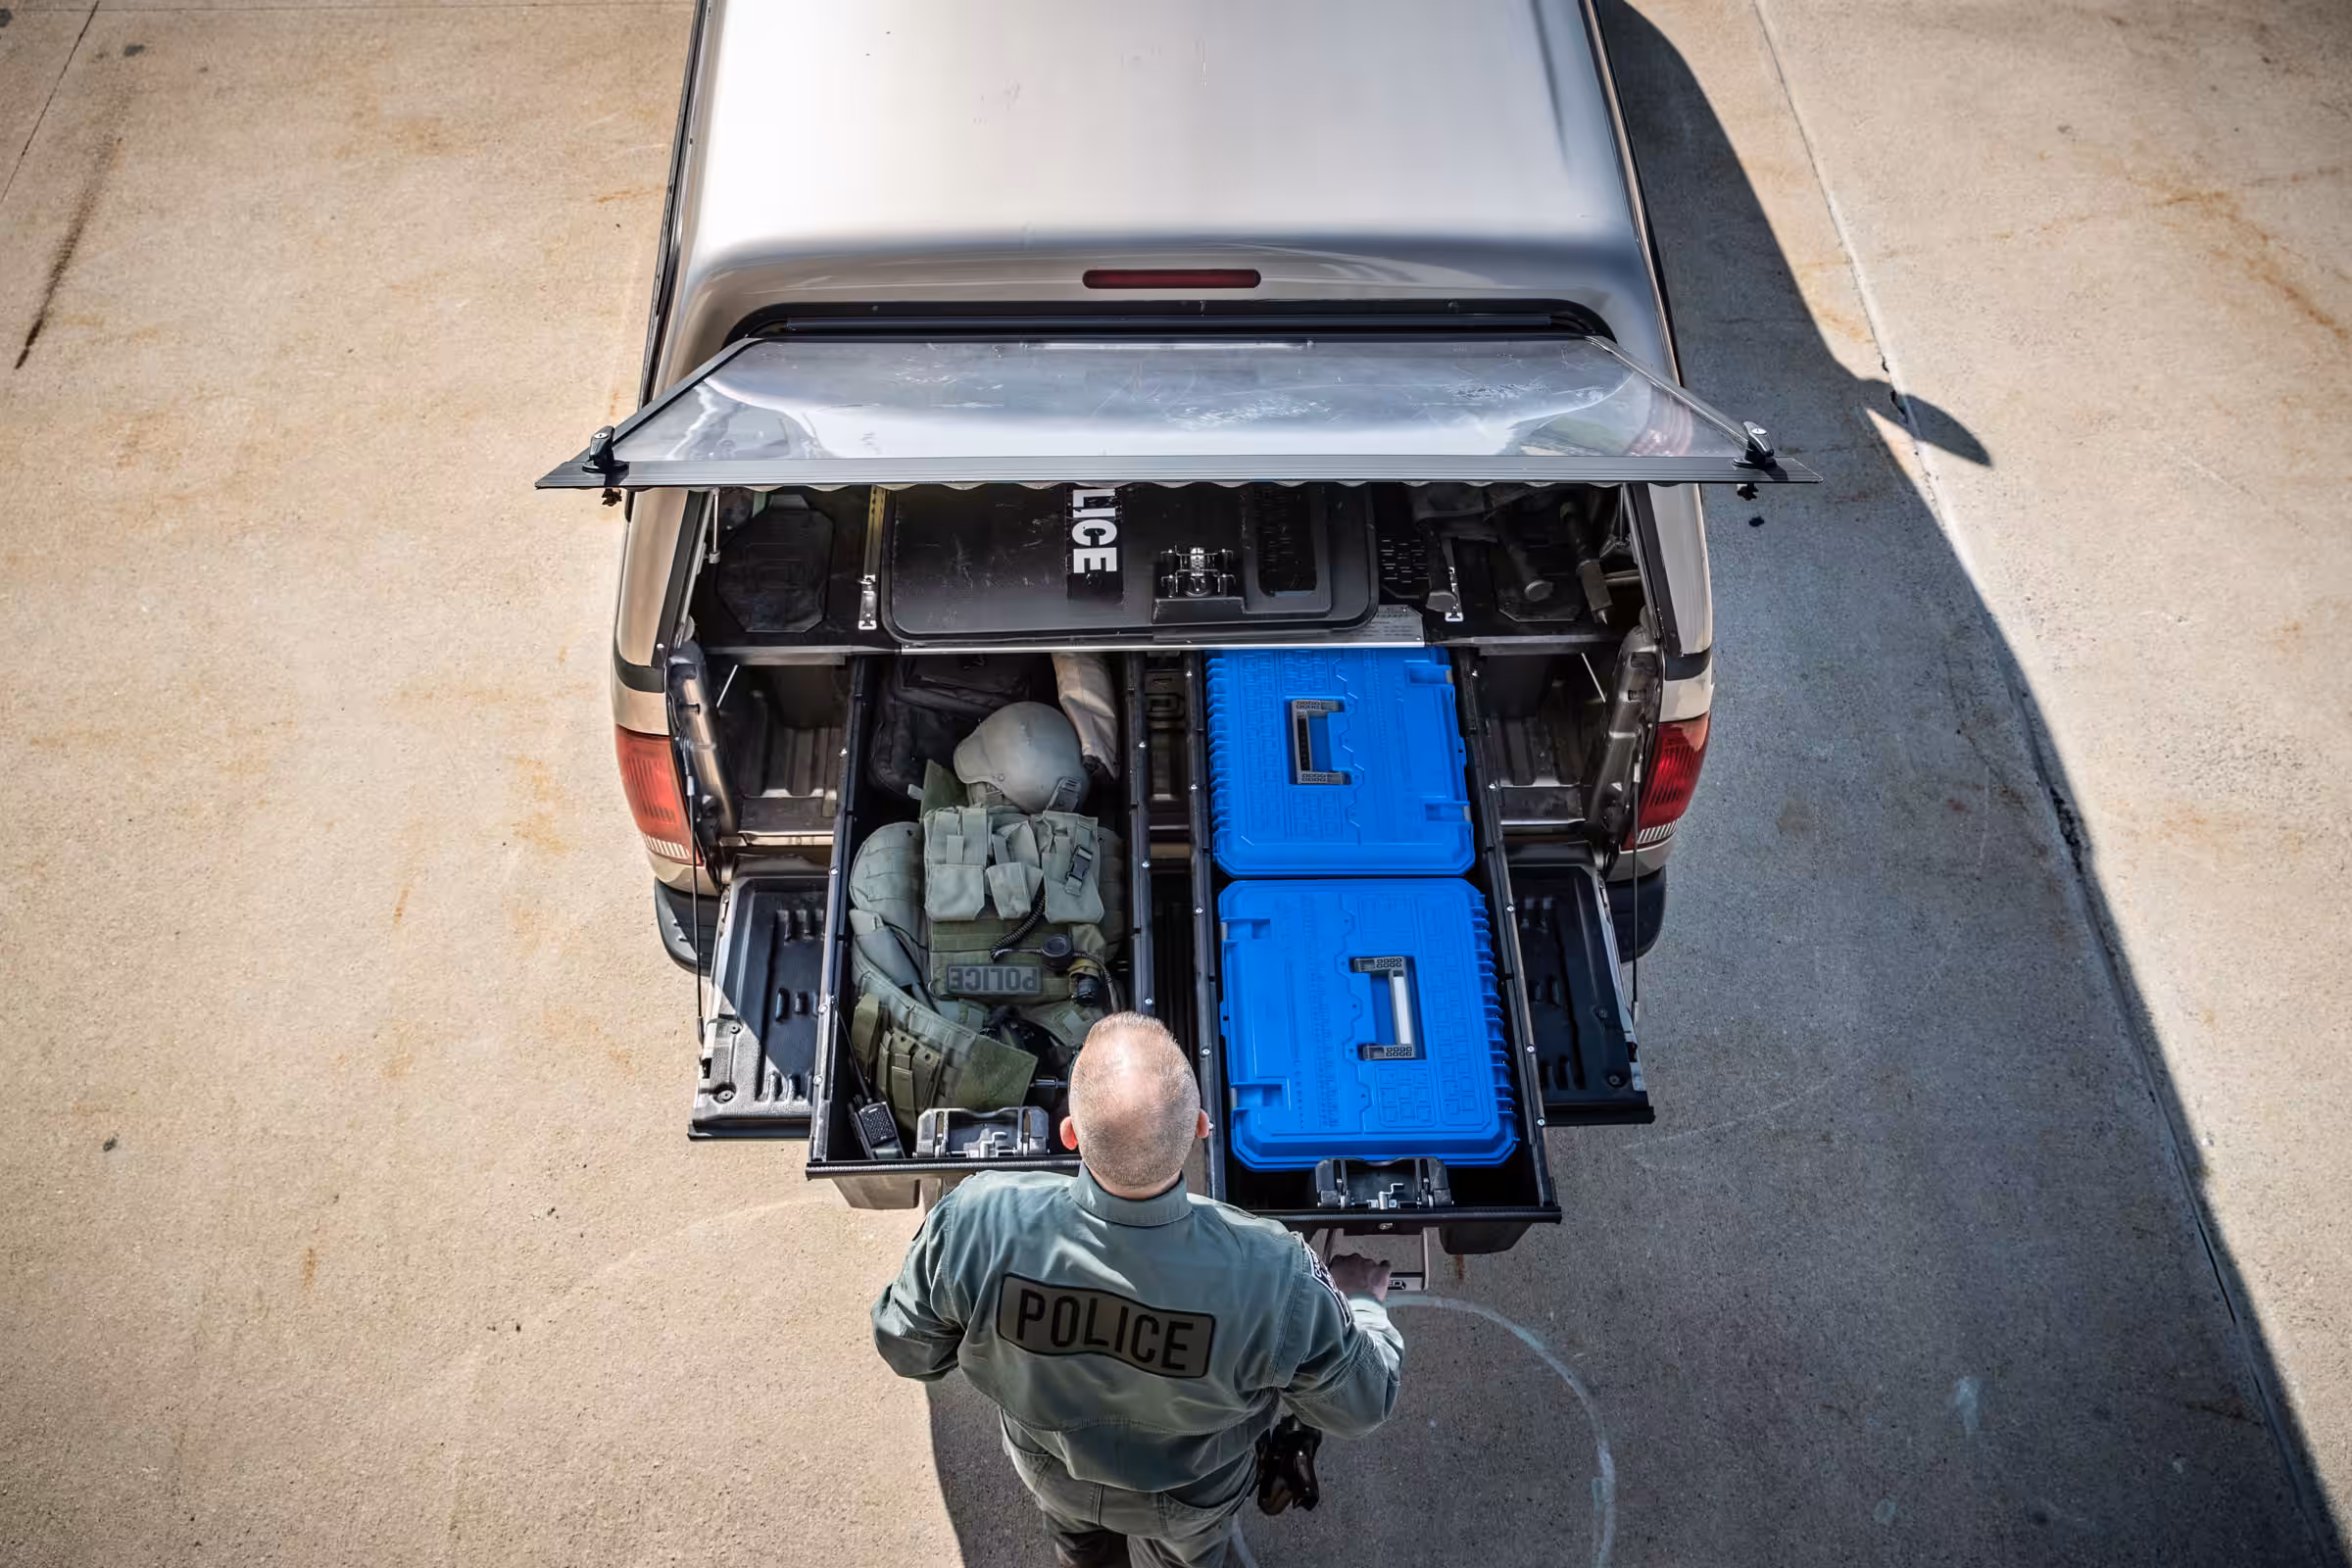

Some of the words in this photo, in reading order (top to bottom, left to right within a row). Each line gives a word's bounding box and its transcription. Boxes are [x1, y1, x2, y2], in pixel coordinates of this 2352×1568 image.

[1072, 488, 1117, 574] LICE
[949, 967, 1039, 992] POLICE
[1016, 1288, 1194, 1371] POLICE
